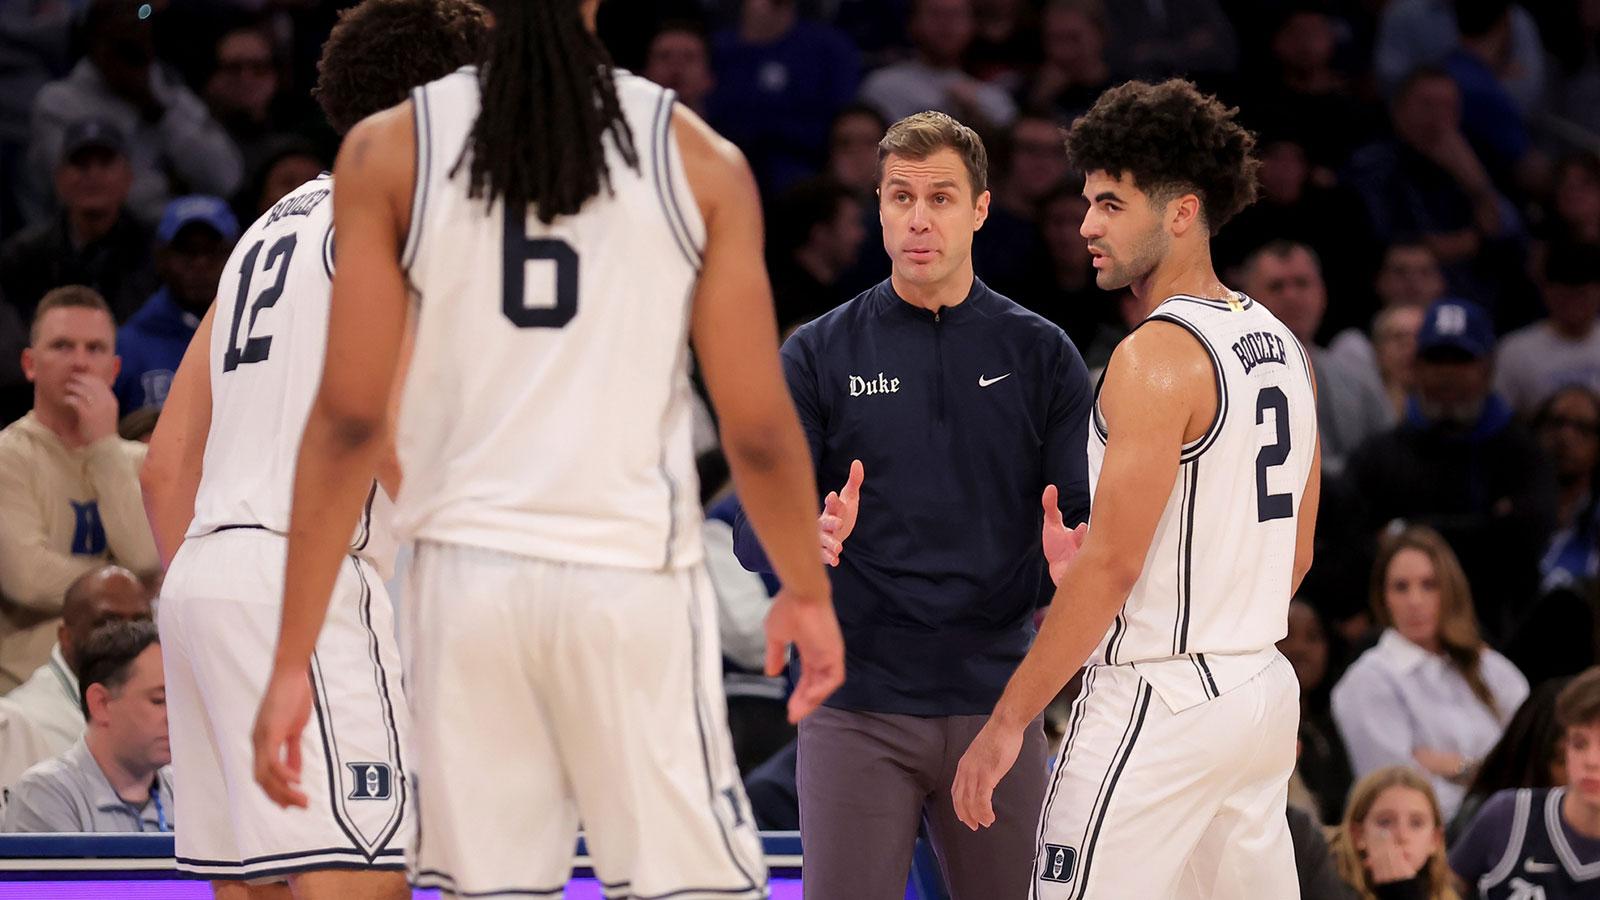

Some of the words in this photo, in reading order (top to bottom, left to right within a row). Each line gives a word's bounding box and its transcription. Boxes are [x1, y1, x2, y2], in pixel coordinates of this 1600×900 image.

[222, 231, 298, 374] 12
[502, 198, 580, 328] 6
[849, 372, 900, 397] Duke
[1255, 385, 1294, 523] 2
